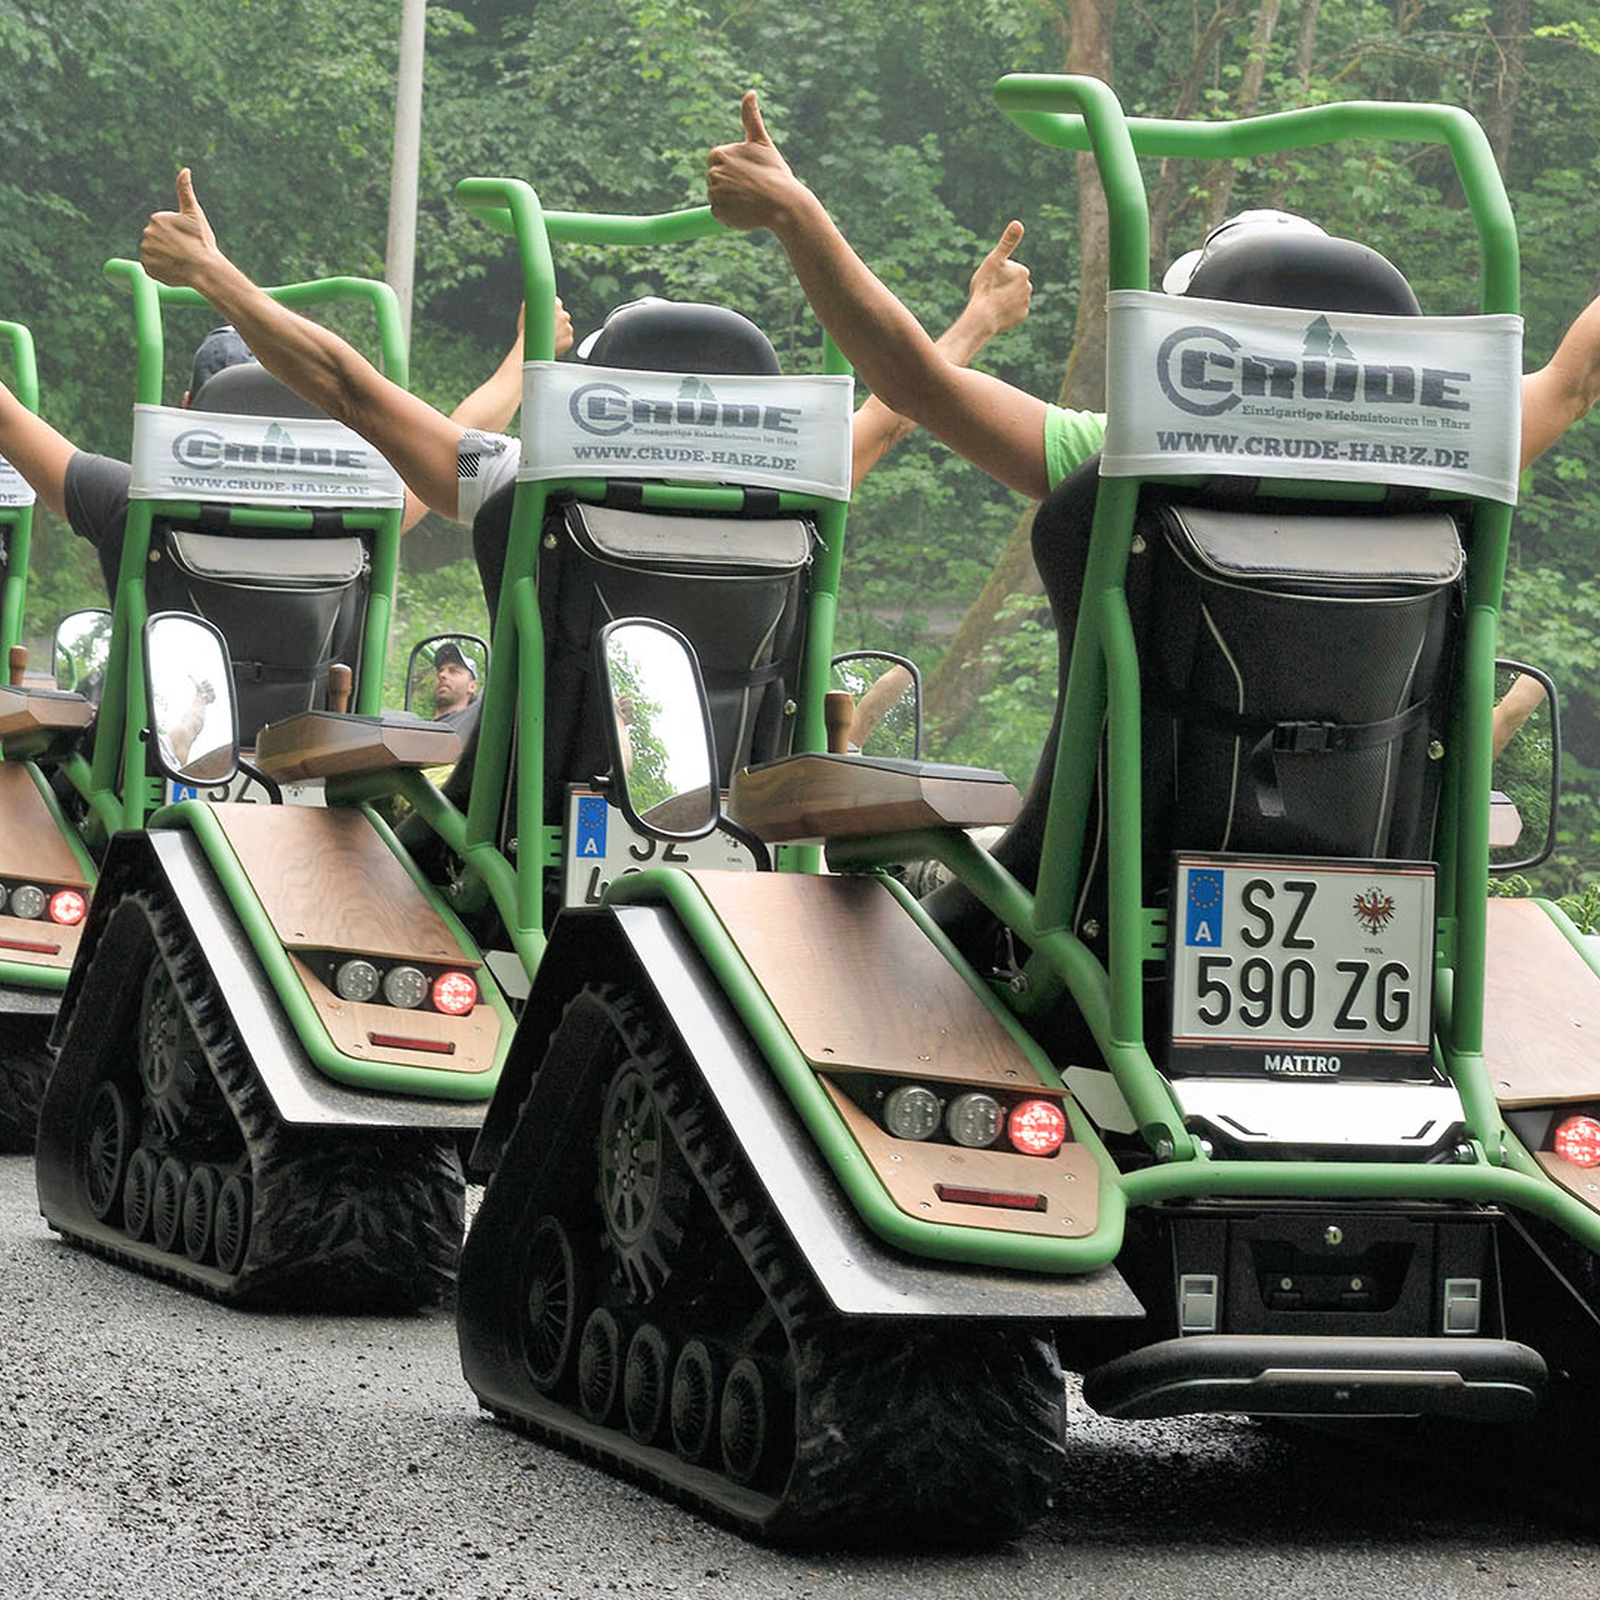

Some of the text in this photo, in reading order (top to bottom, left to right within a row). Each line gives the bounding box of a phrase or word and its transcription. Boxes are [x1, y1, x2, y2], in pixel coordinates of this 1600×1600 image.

[1157, 326, 1471, 417] CRUDE
[569, 383, 801, 436] CRUDE
[172, 430, 367, 470] CRUDE
[572, 445, 797, 471] WWW.CRUDE-HARZ.DE
[1156, 431, 1469, 469] WWW.CRUDE-HARZ.DE
[170, 475, 369, 495] WWW.CRUDE-HARZ.DE
[584, 837, 598, 854] A
[1195, 921, 1212, 942] A
[1241, 879, 1317, 949] SZ
[1198, 956, 1411, 1032] 590 ZG
[1264, 1055, 1342, 1073] MATTRO
